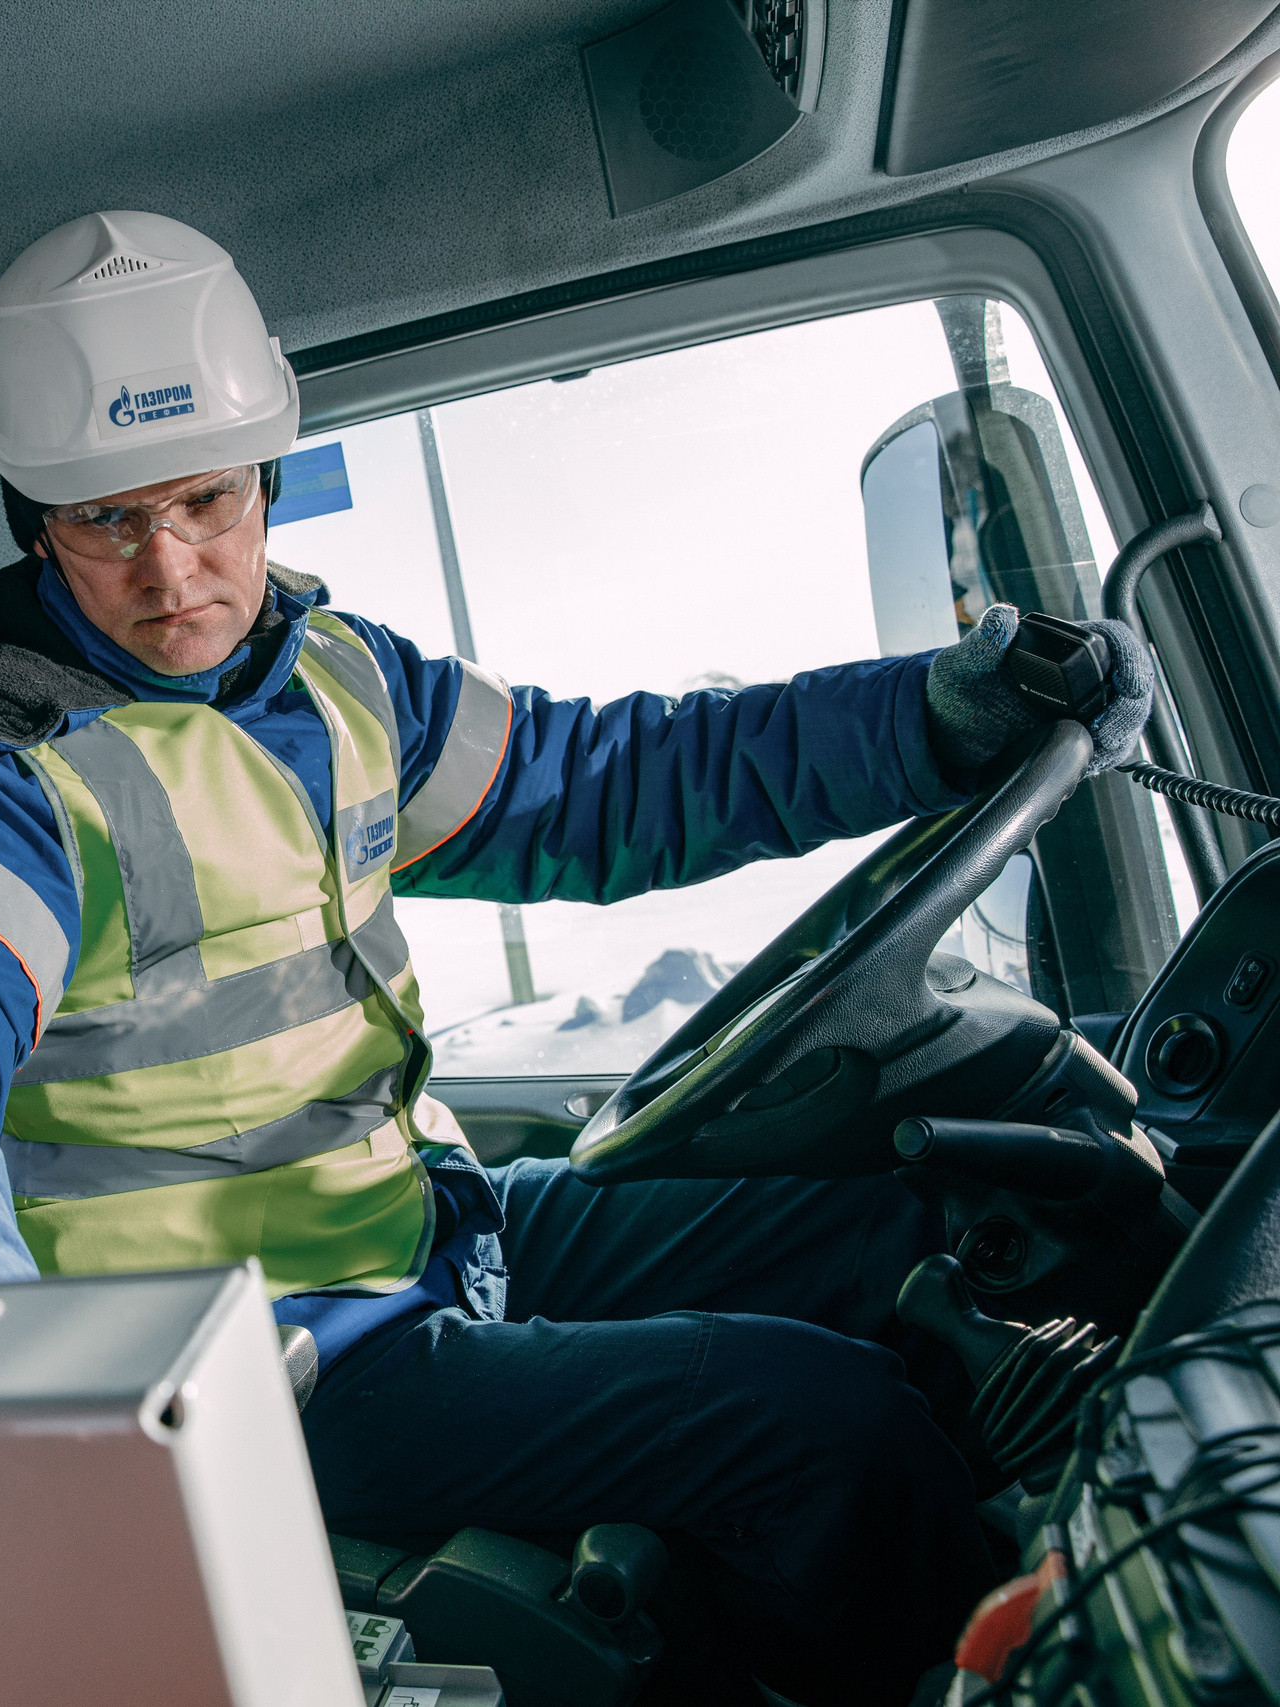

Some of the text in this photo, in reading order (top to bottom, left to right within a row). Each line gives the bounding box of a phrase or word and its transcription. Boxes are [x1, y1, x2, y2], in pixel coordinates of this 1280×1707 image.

[134, 384, 192, 409] ГАЗПРОМ
[140, 405, 193, 421] НЕФТЬ
[1030, 689, 1068, 705] MOTOROLA
[366, 814, 393, 844] ГАЗПРОМ
